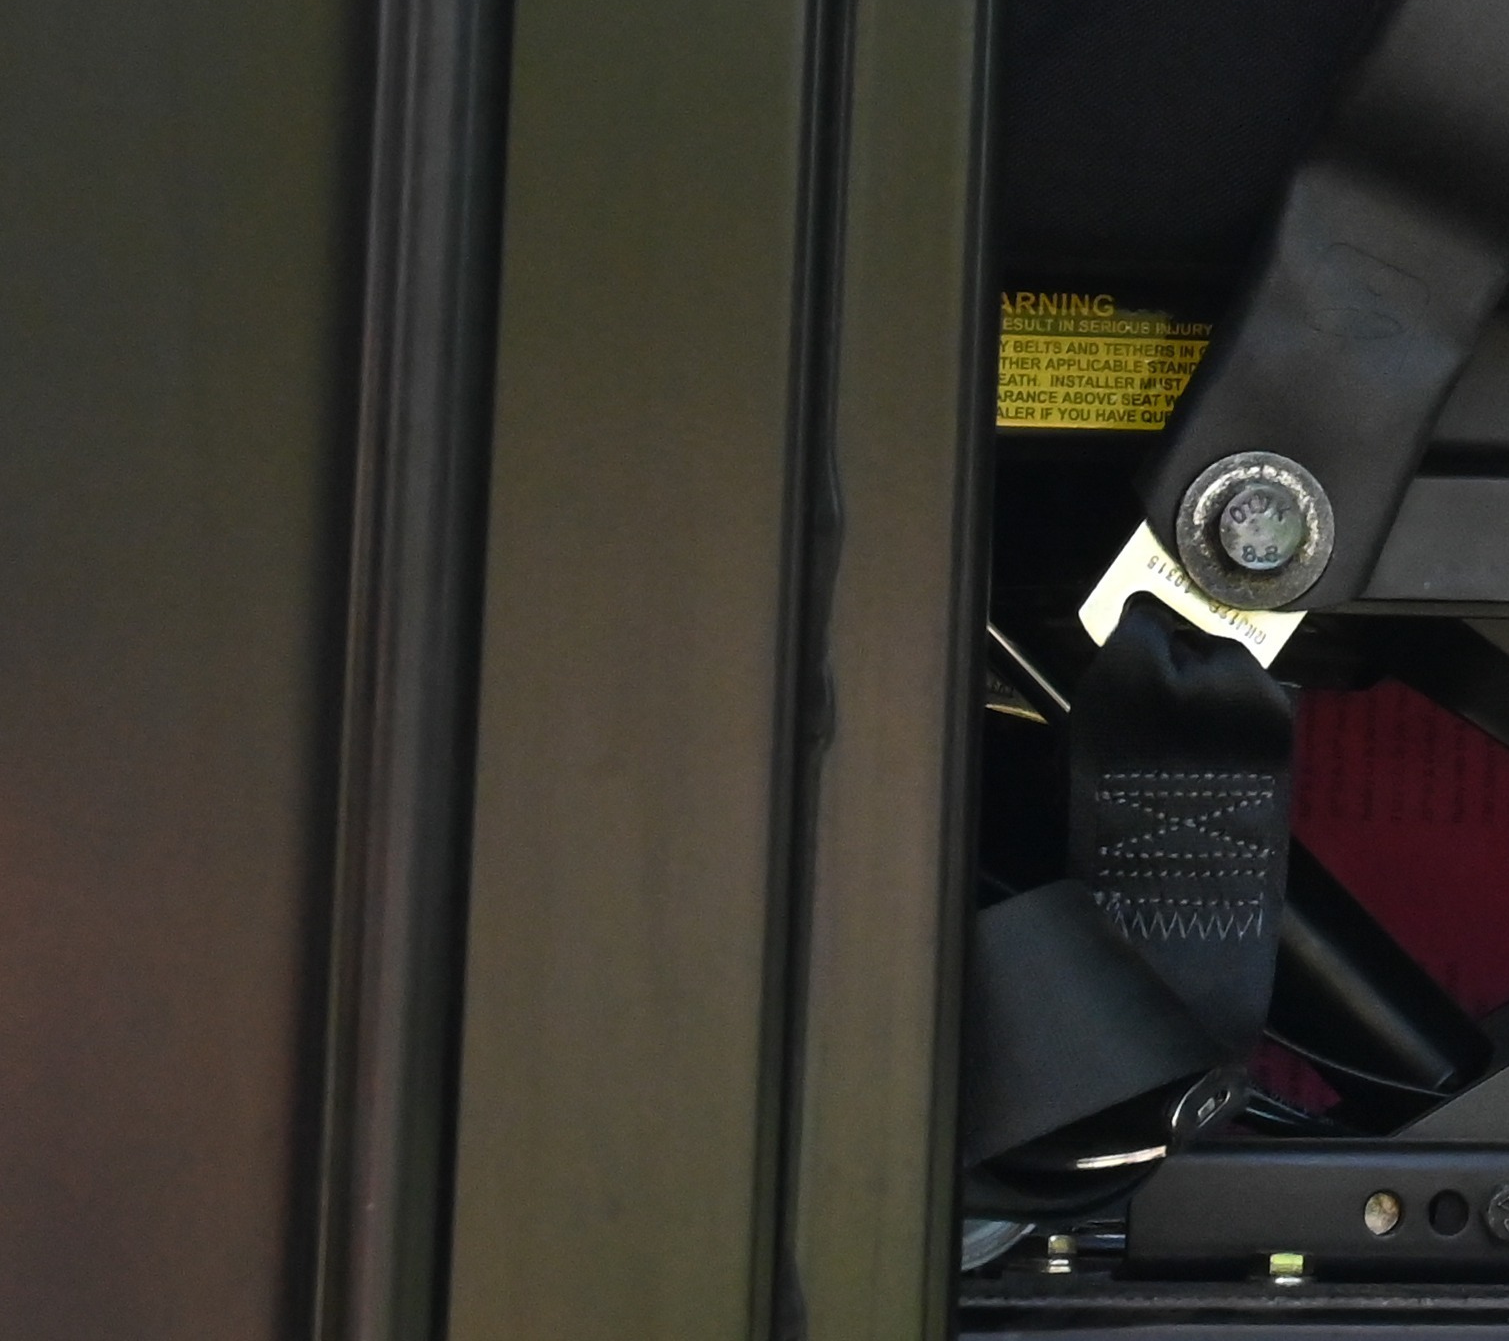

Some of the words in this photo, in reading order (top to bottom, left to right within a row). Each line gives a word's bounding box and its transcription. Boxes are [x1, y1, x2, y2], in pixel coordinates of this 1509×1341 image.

[1001, 291, 1116, 317] ARNING
[1002, 318, 1054, 332] ESULT
[1060, 319, 1074, 332] IN
[1079, 320, 1150, 334] SERIOUS
[1156, 322, 1213, 335] INJURY
[1013, 340, 1061, 354] BELTS
[1066, 342, 1099, 355] AND
[1104, 343, 1175, 357] TETHERS
[1180, 345, 1194, 358] IN
[1000, 356, 1041, 370] THER
[1045, 358, 1143, 374] APPLICABLE
[1050, 374, 1135, 389] INSTALLER
[1140, 377, 1182, 391] MUST
[1061, 391, 1117, 405] ABOVE
[1121, 393, 1162, 407] SEAT
[1040, 407, 1053, 420] IF
[1057, 407, 1091, 421] YOU
[1095, 409, 1137, 423] HAVE
